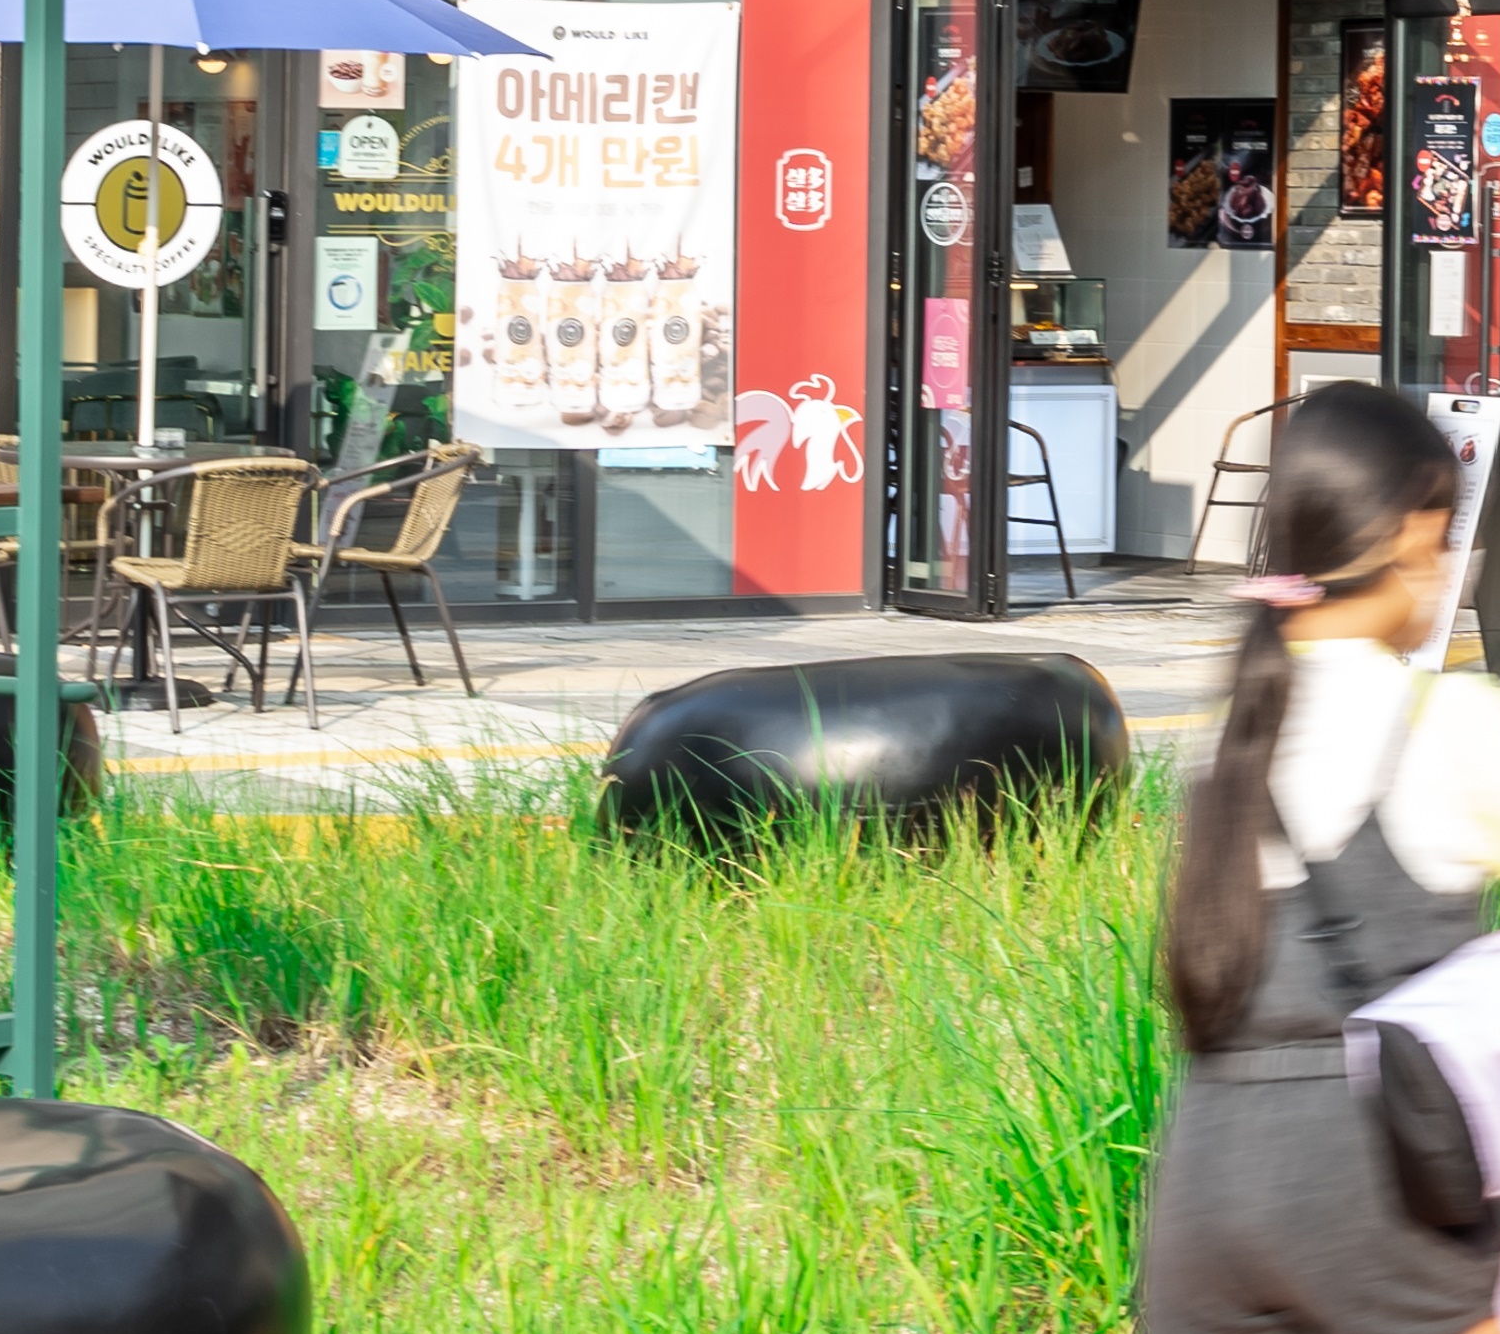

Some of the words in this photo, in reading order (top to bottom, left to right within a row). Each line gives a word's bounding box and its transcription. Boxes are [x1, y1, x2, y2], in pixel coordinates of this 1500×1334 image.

[497, 67, 700, 125] 아메리캔
[350, 136, 389, 150] OPEN
[494, 133, 580, 188] 4개
[601, 133, 700, 188] 만원
[388, 351, 452, 372] TAKE
